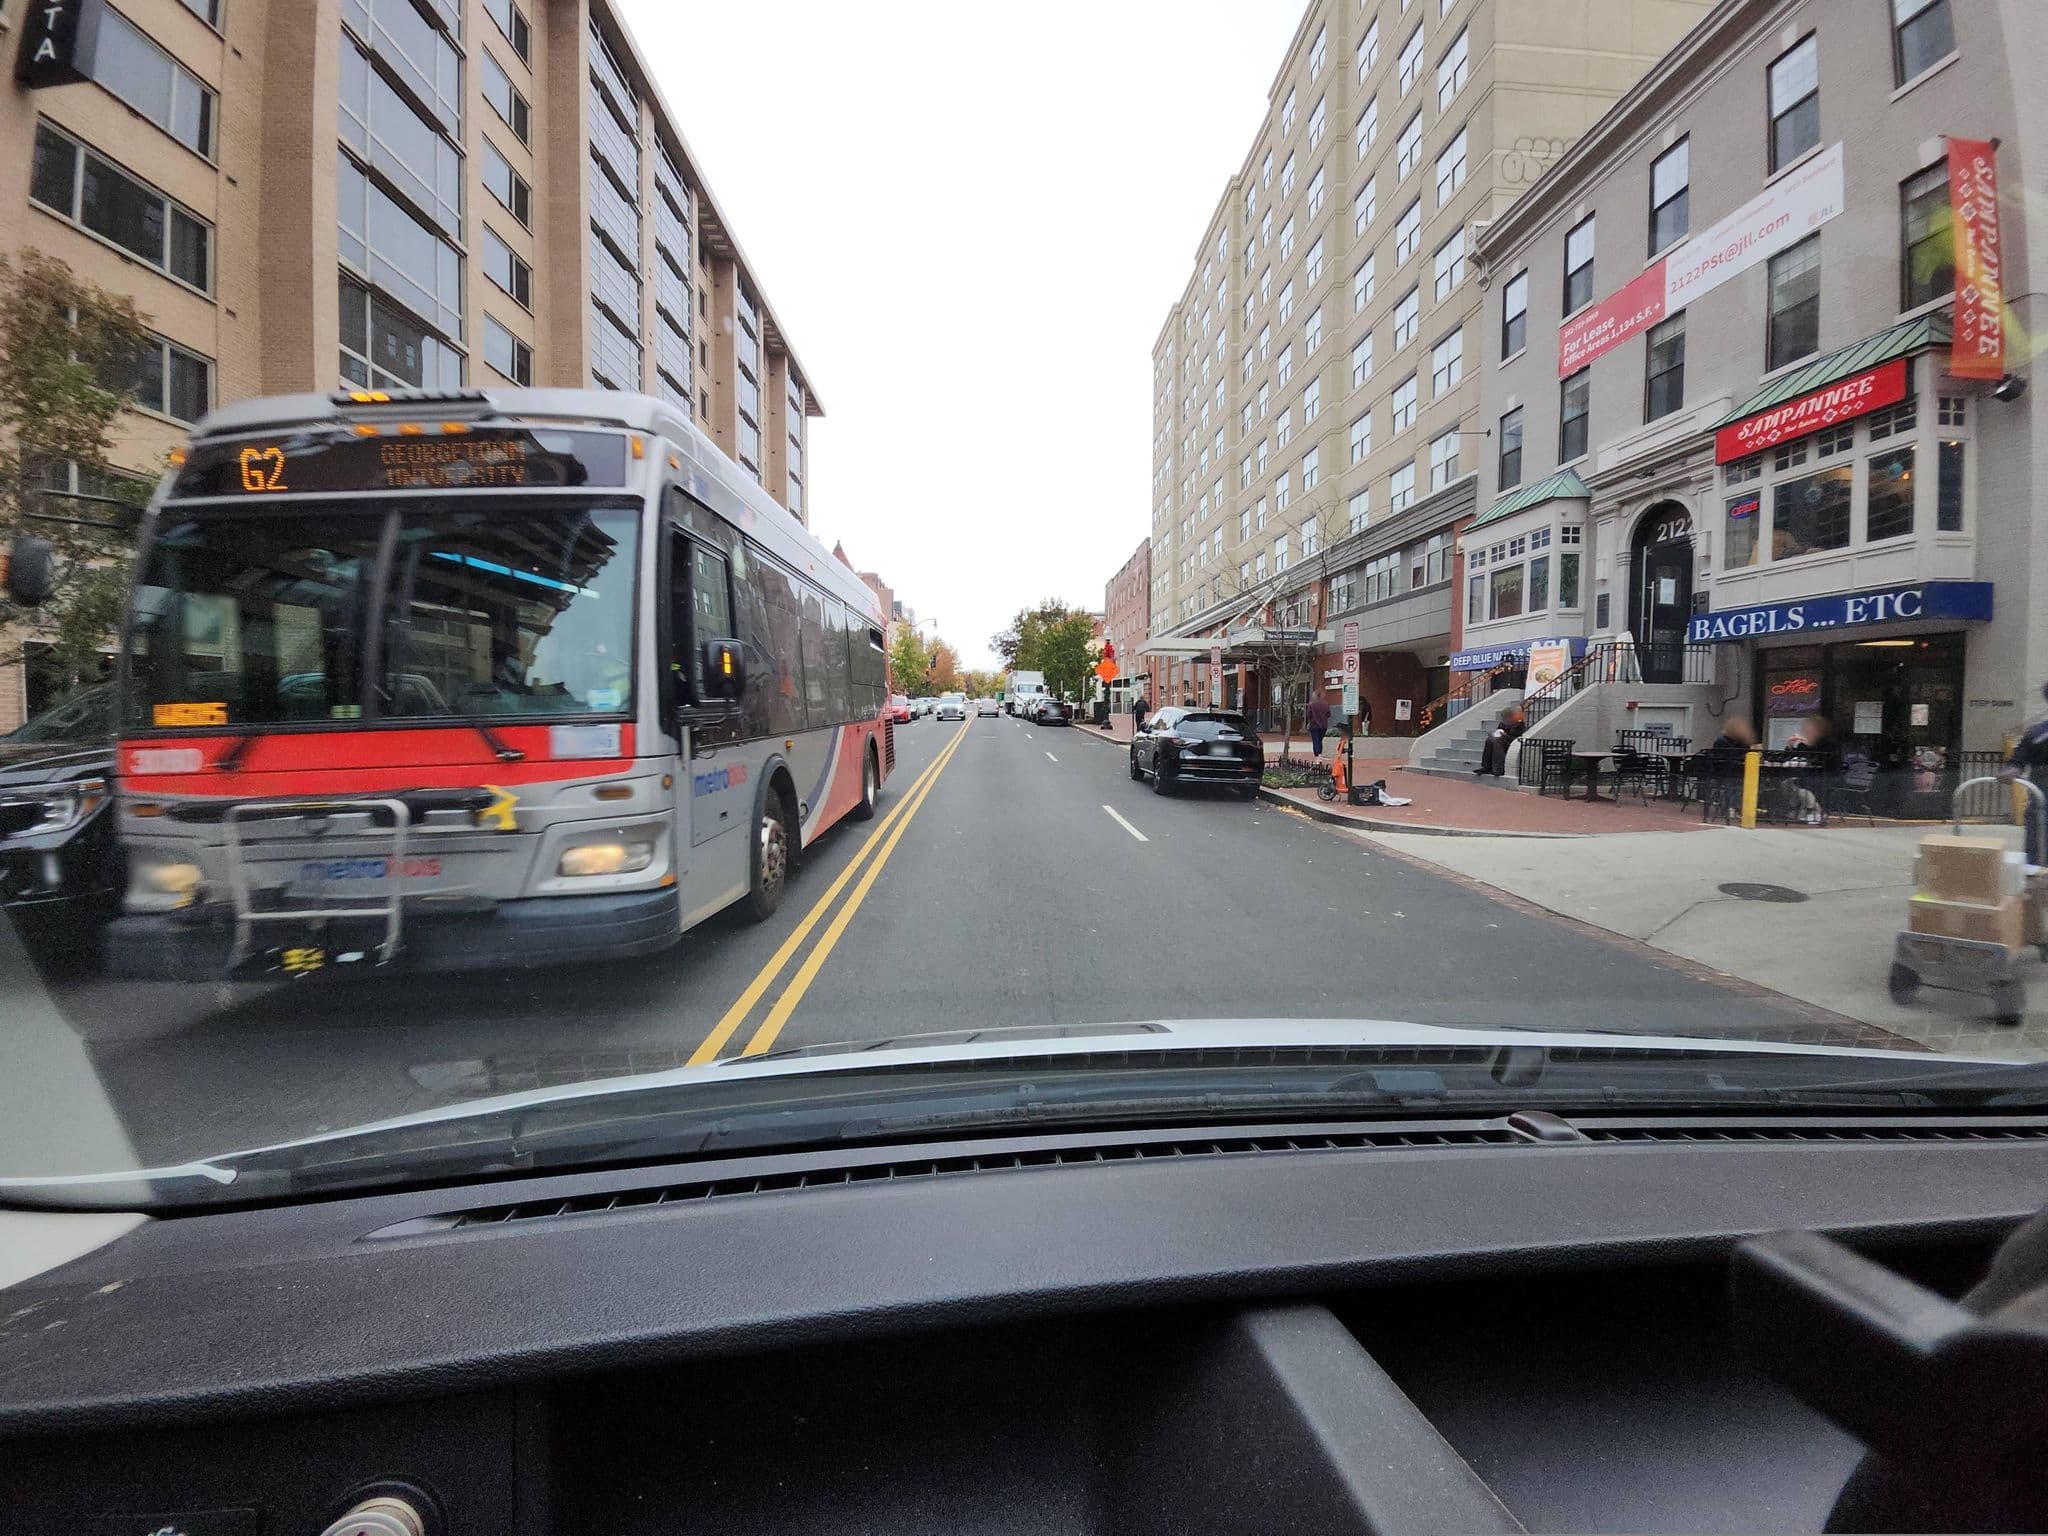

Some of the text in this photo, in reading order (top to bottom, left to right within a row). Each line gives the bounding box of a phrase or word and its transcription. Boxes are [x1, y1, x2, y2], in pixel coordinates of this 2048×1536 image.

[34, 0, 64, 62] TA
[1670, 212, 1790, 295] 2122PSt@jll.com
[1972, 156, 2001, 359] SAMPANNEE
[1563, 348, 1586, 367] Office
[1586, 334, 1610, 354] Areas
[1610, 319, 1635, 339] 1,134
[1635, 305, 1653, 325] S.F.
[1563, 316, 1616, 357] For Lease
[1737, 374, 1876, 441] SAMPANNEE
[239, 447, 288, 491] G2
[1694, 605, 1805, 641] BAGELS
[1844, 590, 1923, 625] ETC
[1453, 655, 1472, 667] DEEP
[1472, 653, 1492, 665] BLUE
